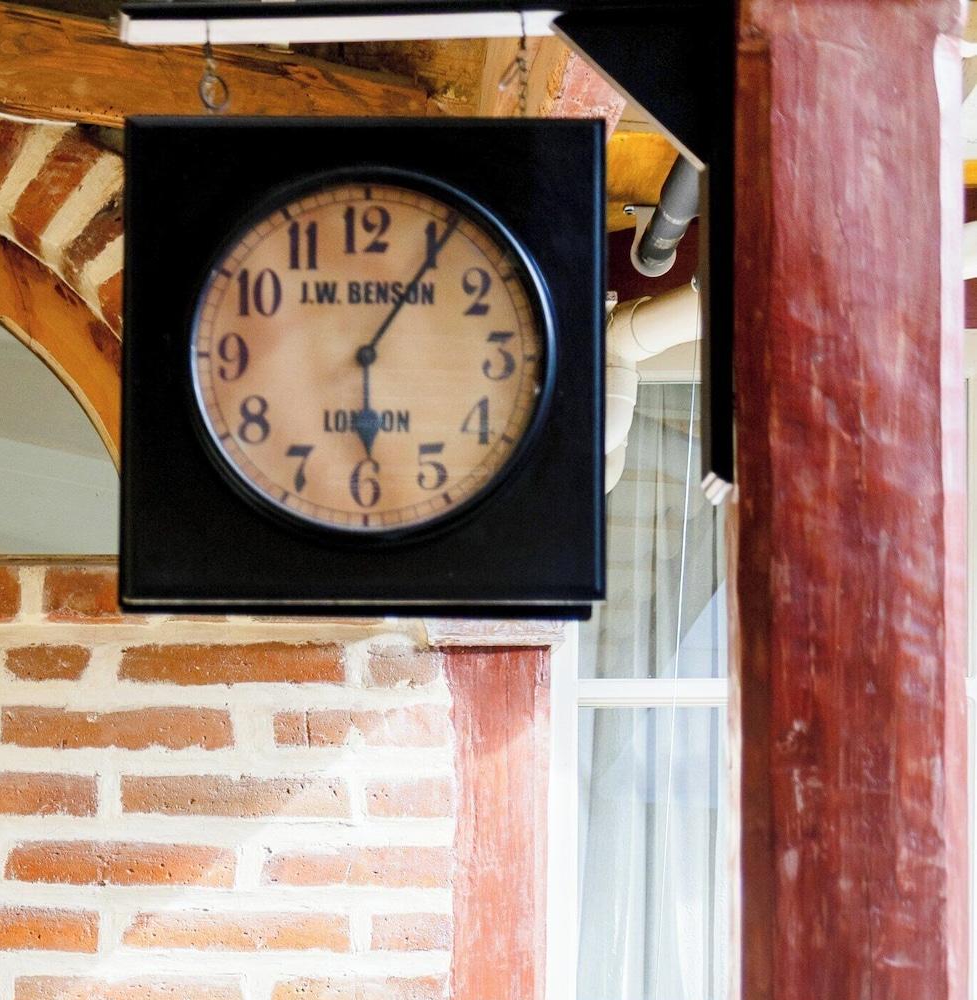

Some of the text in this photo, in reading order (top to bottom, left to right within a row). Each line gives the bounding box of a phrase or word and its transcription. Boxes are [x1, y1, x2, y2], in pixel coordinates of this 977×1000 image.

[288, 220, 318, 270] 11
[343, 205, 391, 254] 12
[425, 220, 438, 270] 1
[237, 267, 282, 317] 10
[300, 281, 435, 305] J.W. BENSON
[461, 267, 492, 316] 2
[218, 332, 250, 381] 9
[481, 331, 516, 380] 3
[237, 394, 271, 445] 8
[323, 409, 410, 432] LONON
[459, 395, 496, 445] 4
[285, 444, 315, 493] 7
[349, 457, 381, 508] 6
[416, 442, 449, 490] 5
